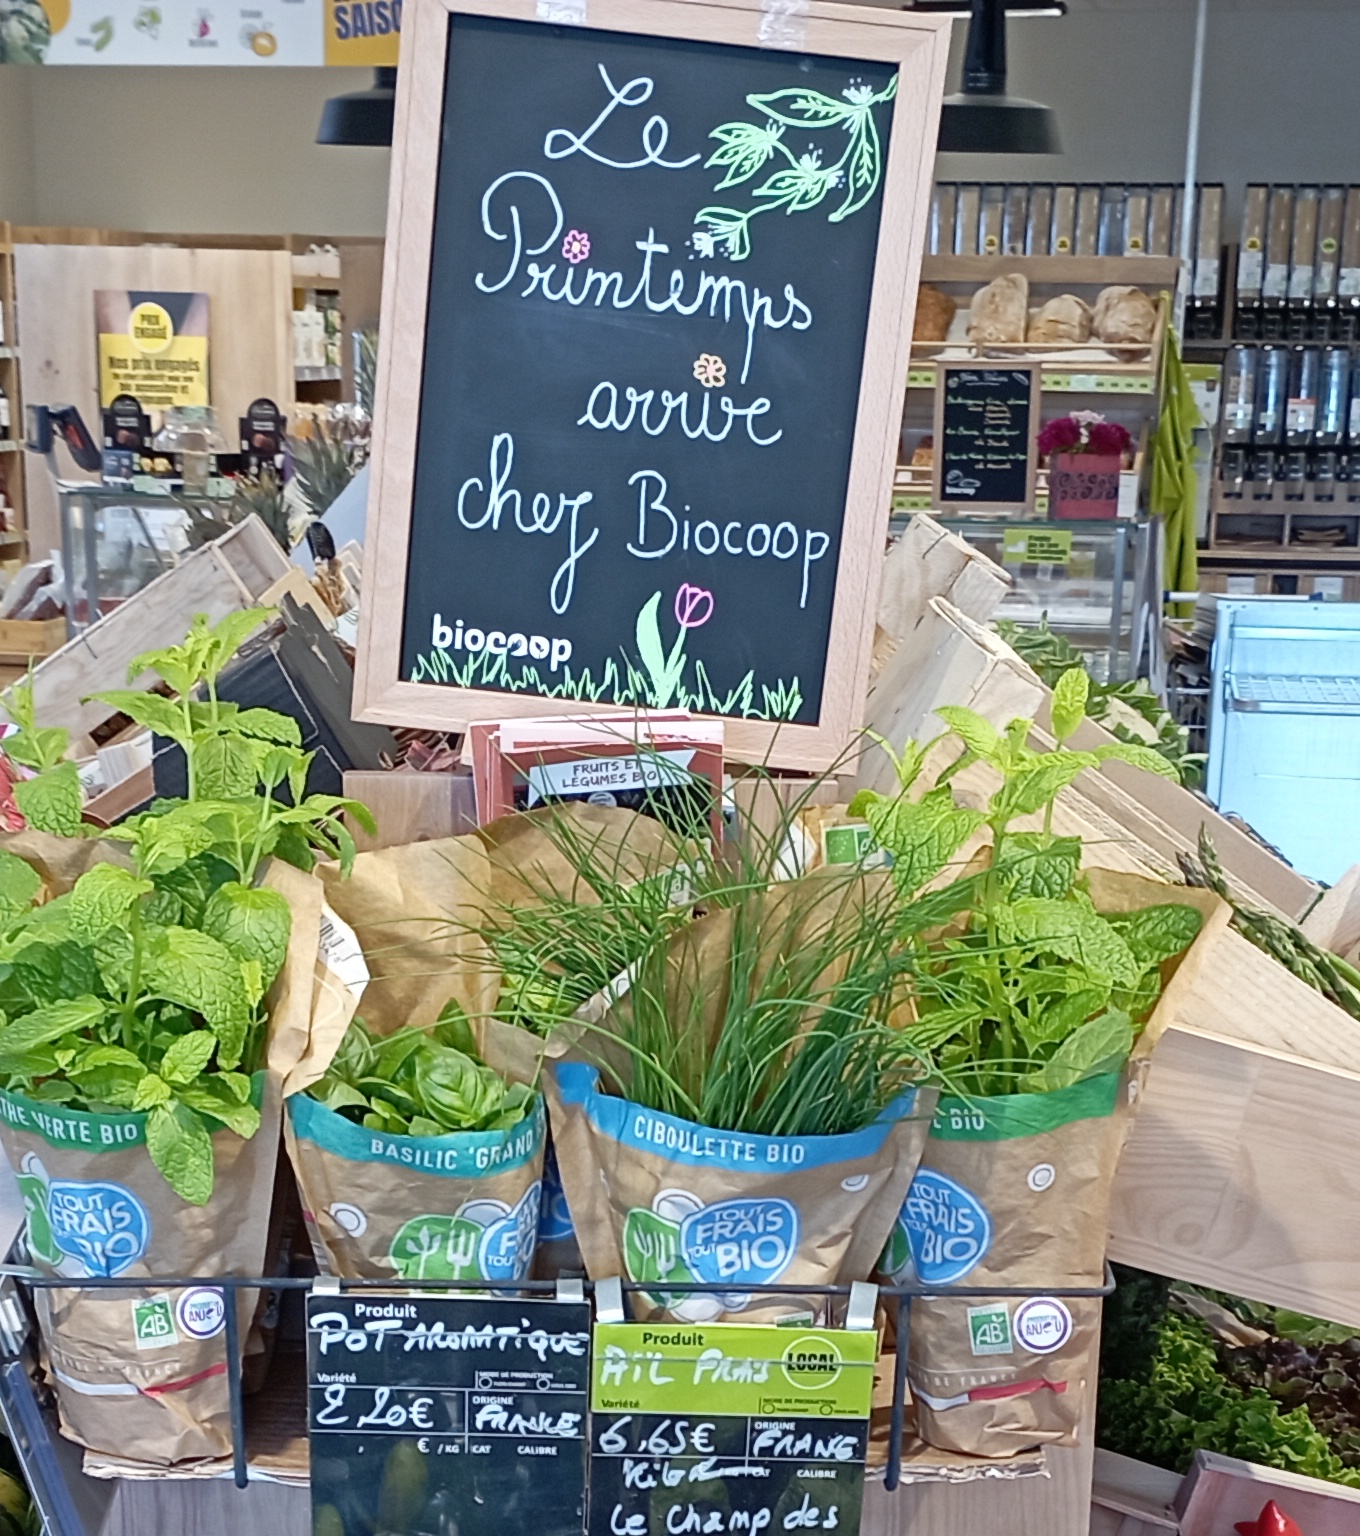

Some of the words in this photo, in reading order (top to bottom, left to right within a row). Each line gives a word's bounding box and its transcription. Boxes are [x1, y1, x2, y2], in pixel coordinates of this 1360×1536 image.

[544, 63, 702, 169] Le
[475, 170, 813, 385] Printemps
[577, 381, 783, 446] arrive
[457, 432, 600, 615] chez
[626, 469, 830, 608] Biocoop
[432, 613, 572, 671] biocoop
[572, 761, 619, 777] FRUITS
[31, 1111, 91, 1143] VERTE
[100, 1123, 138, 1145] BIO
[950, 1107, 985, 1131] BIO
[633, 1115, 757, 1162] CIBOULETTE
[766, 1143, 805, 1164] BIO
[371, 1138, 458, 1170] BASILIC
[53, 1190, 104, 1212] TOUT
[912, 1182, 951, 1205] TOUT
[52, 1200, 131, 1236] FRAIS
[713, 1203, 766, 1222] TOUT
[905, 1196, 976, 1235] FRAIS
[696, 1208, 784, 1246] FRAIS
[715, 1234, 787, 1278] BIO
[920, 1228, 978, 1265] BIO
[354, 1303, 418, 1319] Produit
[140, 1313, 170, 1339] AB
[642, 1331, 705, 1347] Produit
[976, 1321, 1005, 1347] AB
[787, 1353, 838, 1373] LOCAL
[317, 1371, 357, 1384] Variété
[472, 1395, 514, 1405] ORIGINE
[601, 1398, 640, 1409] Variété
[754, 1421, 796, 1431] ORIGINE
[417, 1437, 430, 1454] €
[472, 1445, 492, 1455] CAT
[517, 1445, 558, 1456] CALIBRE
[796, 1468, 837, 1479] CALIBRE
[783, 1492, 839, 1530] des
